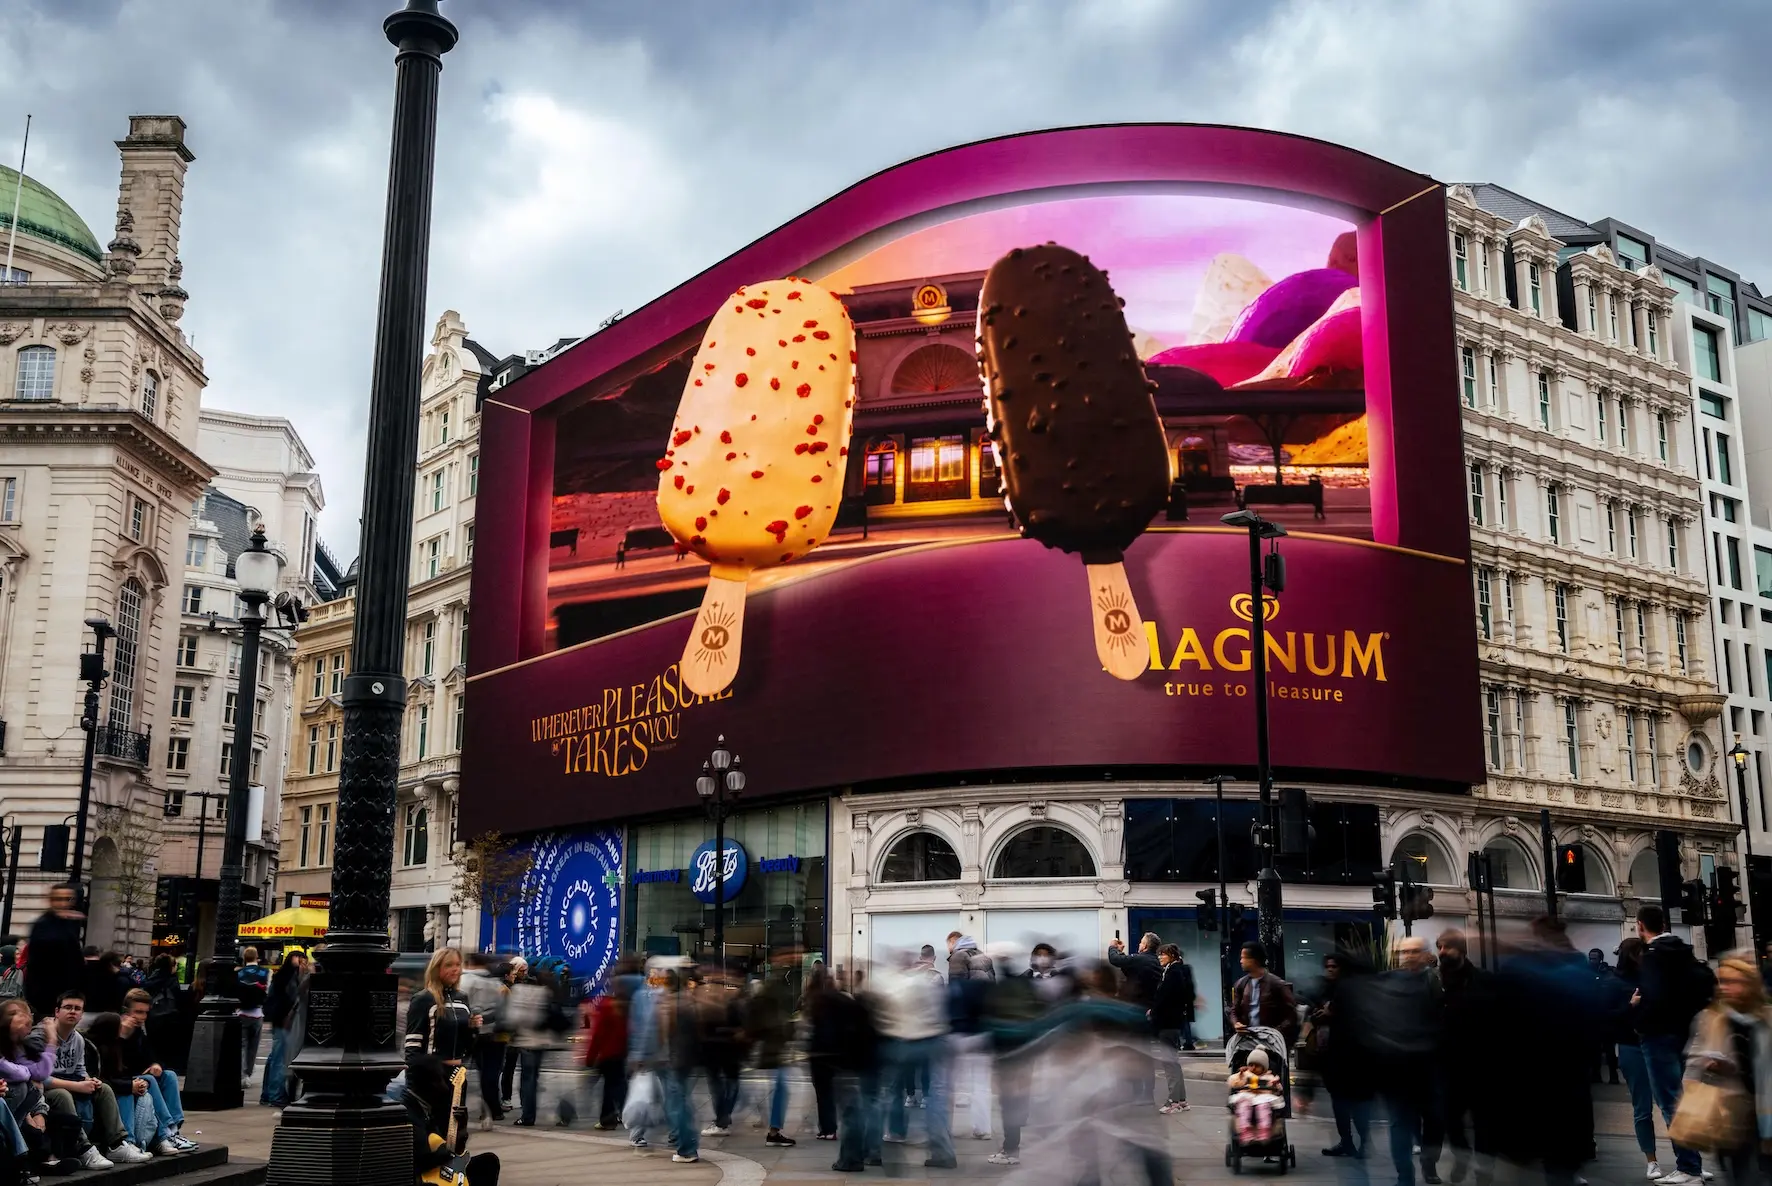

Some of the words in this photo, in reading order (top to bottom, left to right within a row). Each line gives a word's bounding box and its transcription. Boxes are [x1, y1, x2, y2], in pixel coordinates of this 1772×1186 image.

[142, 473, 154, 488] LIFE
[156, 483, 173, 500] OFFICE
[704, 629, 725, 647] M
[1164, 681, 1214, 697] true
[1223, 681, 1247, 697] to
[1270, 681, 1344, 702] leasure
[531, 703, 602, 743] WHEREVER
[560, 721, 650, 778] TAKES
[649, 712, 682, 744] YOU
[543, 844, 558, 871] YOU
[604, 837, 620, 864] AND
[759, 854, 800, 874] beauty
[632, 868, 681, 887] pharmacy
[534, 872, 548, 911] WITH
[559, 879, 599, 931] PICCADILLY
[551, 846, 573, 884] GREAT
[574, 841, 583, 854] IN
[595, 916, 618, 982] BEATING
[240, 926, 256, 934] HOT
[257, 926, 273, 934] DOG
[274, 926, 293, 934] SPOT
[533, 915, 542, 958] HERE
[561, 931, 595, 960] LIGHTS
